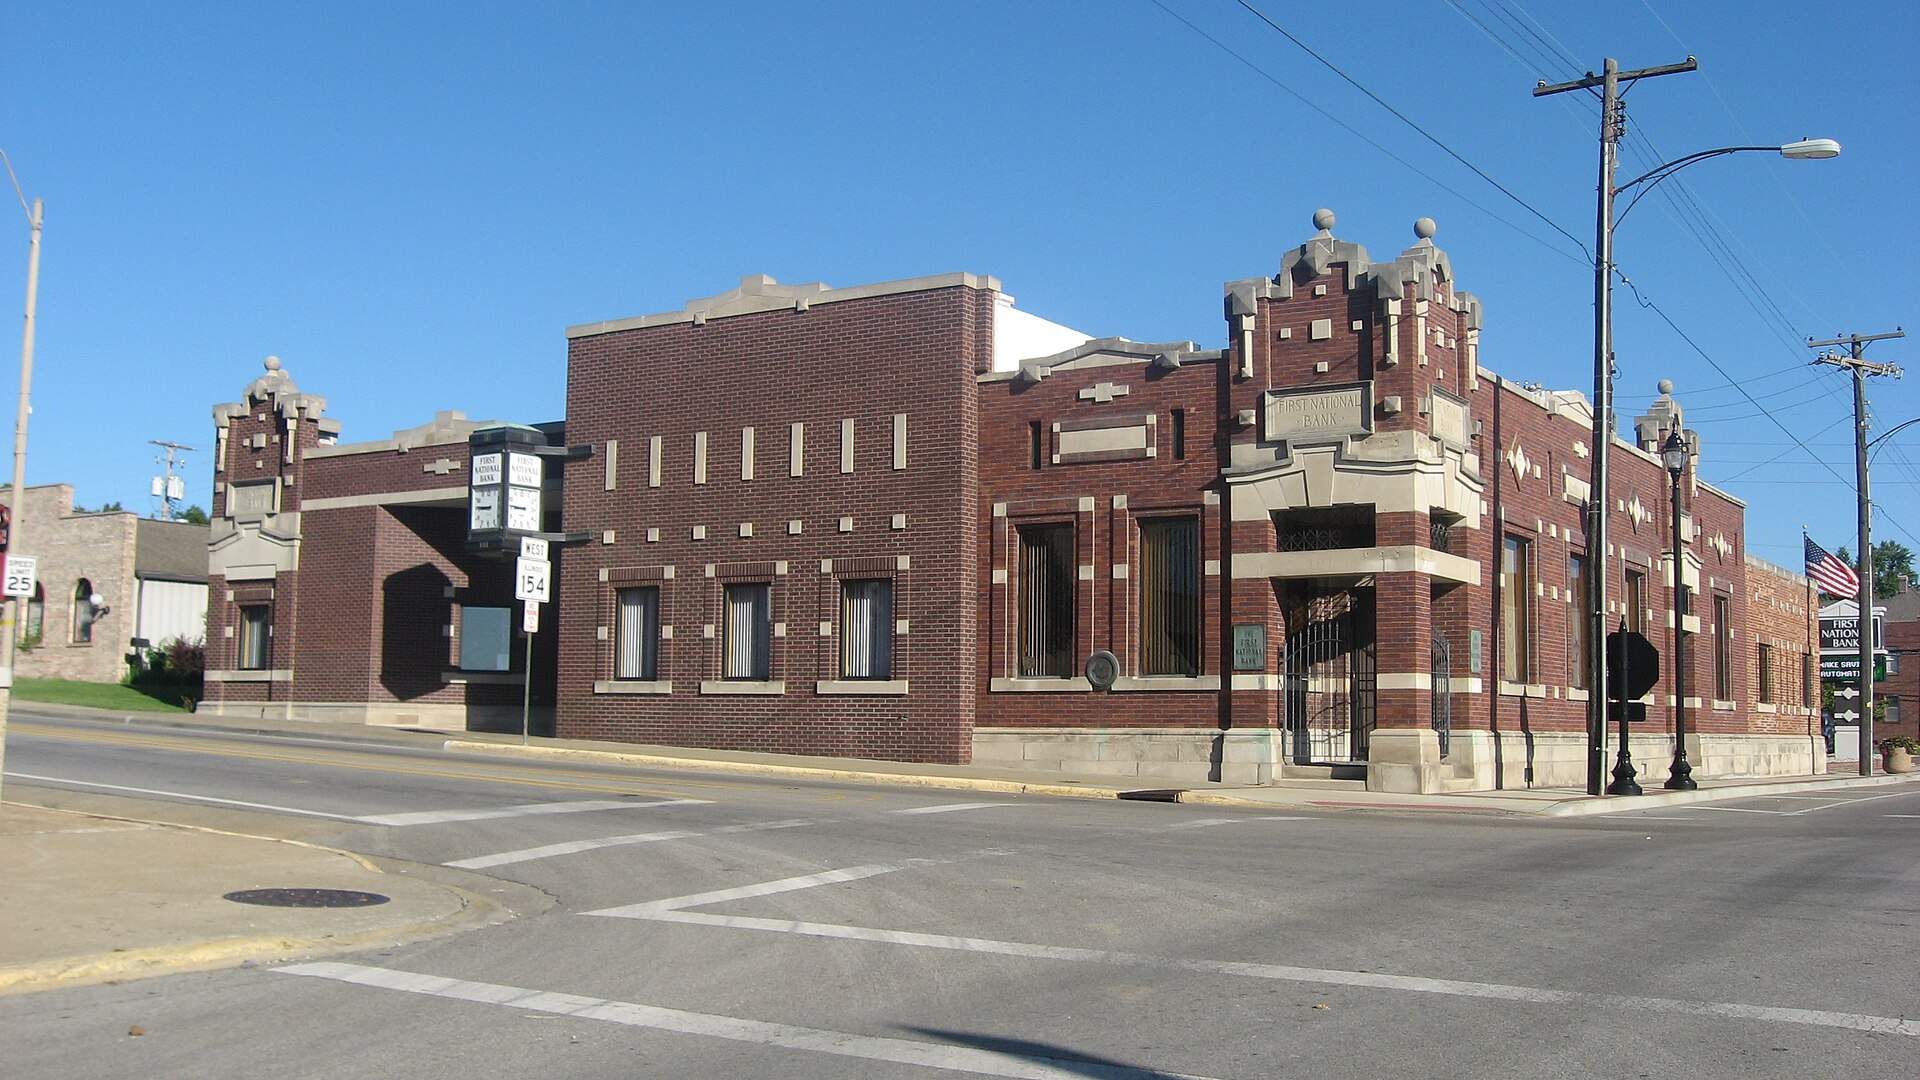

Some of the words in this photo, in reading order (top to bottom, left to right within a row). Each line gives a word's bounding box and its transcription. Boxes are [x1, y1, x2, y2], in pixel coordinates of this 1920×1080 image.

[1278, 398, 1308, 413] FIRST
[1310, 393, 1361, 411] NATIONAL
[1303, 413, 1336, 427] BANK
[480, 456, 495, 464] FIRST
[517, 457, 533, 465] FIRST
[475, 465, 500, 473] NATIONAL
[480, 474, 495, 482] BANK
[526, 543, 544, 556] WEST
[8, 576, 31, 590] 25
[522, 575, 544, 595] 154
[1833, 620, 1858, 628] FIRST
[1821, 629, 1859, 638] NATION
[1833, 639, 1859, 647] BANK
